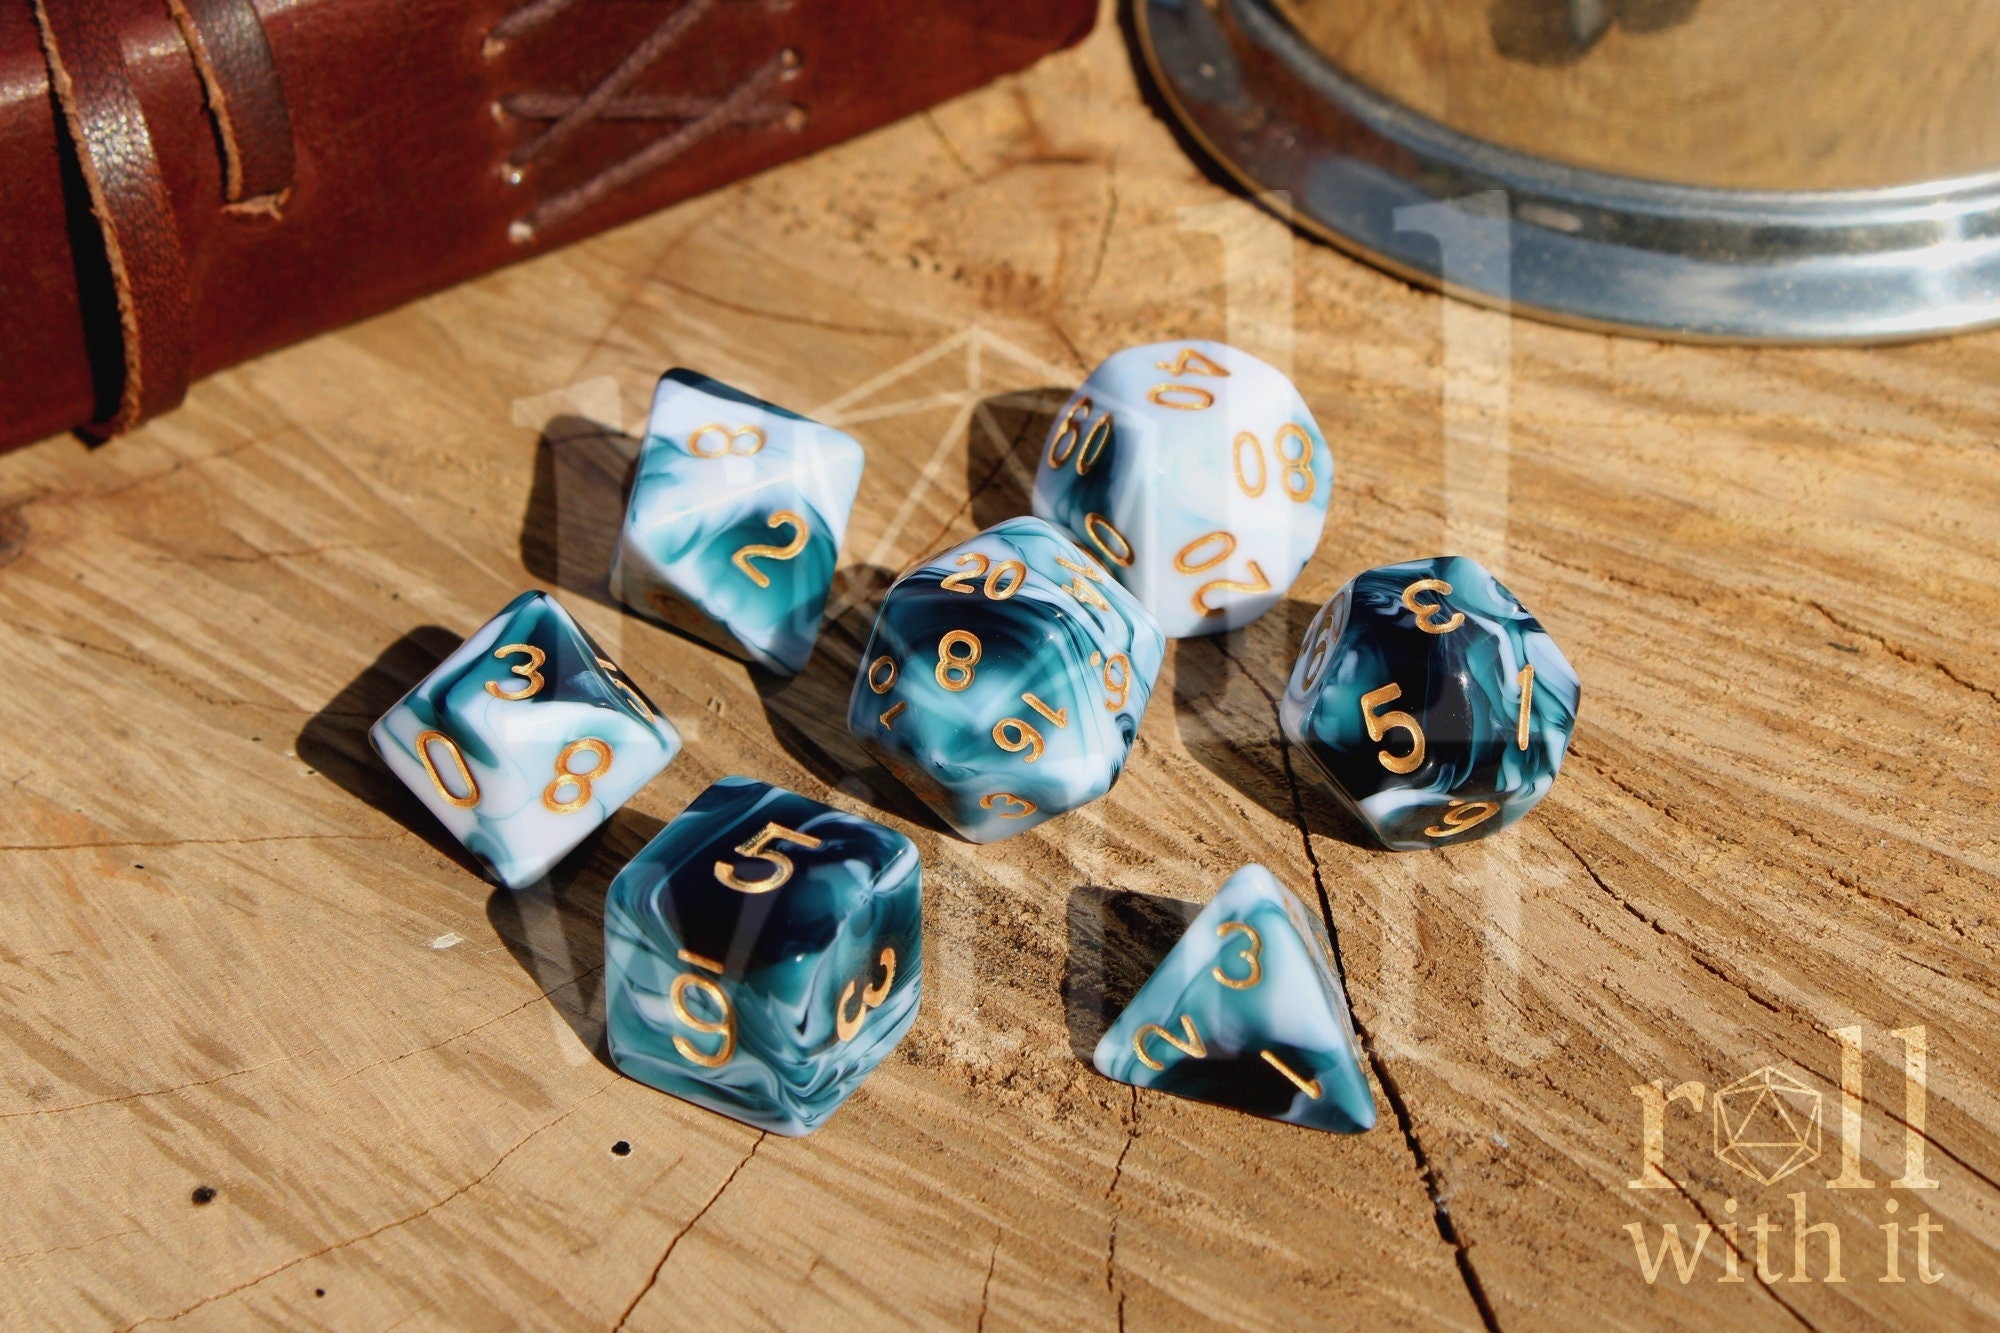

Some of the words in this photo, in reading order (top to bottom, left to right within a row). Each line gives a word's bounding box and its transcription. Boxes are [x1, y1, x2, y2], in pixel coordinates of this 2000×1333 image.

[1148, 346, 1231, 410] 40
[688, 423, 767, 460] 8
[1048, 396, 1113, 475] 60
[1233, 422, 1316, 502] 80
[732, 509, 810, 588] 2
[940, 552, 1027, 601] 20
[1173, 531, 1272, 618] 20
[1402, 579, 1465, 634] 3
[484, 643, 545, 700] 3
[934, 630, 982, 691] 8
[1361, 682, 1426, 774] 5
[1517, 664, 1535, 751] 1
[415, 729, 480, 810] 0
[541, 737, 614, 815] 8
[979, 792, 1038, 819] 3
[713, 821, 823, 893] 5
[1213, 921, 1262, 990] 3
[836, 948, 897, 1042] 3
[1132, 1015, 1207, 1071] 2
[1260, 1050, 1322, 1100] 1
